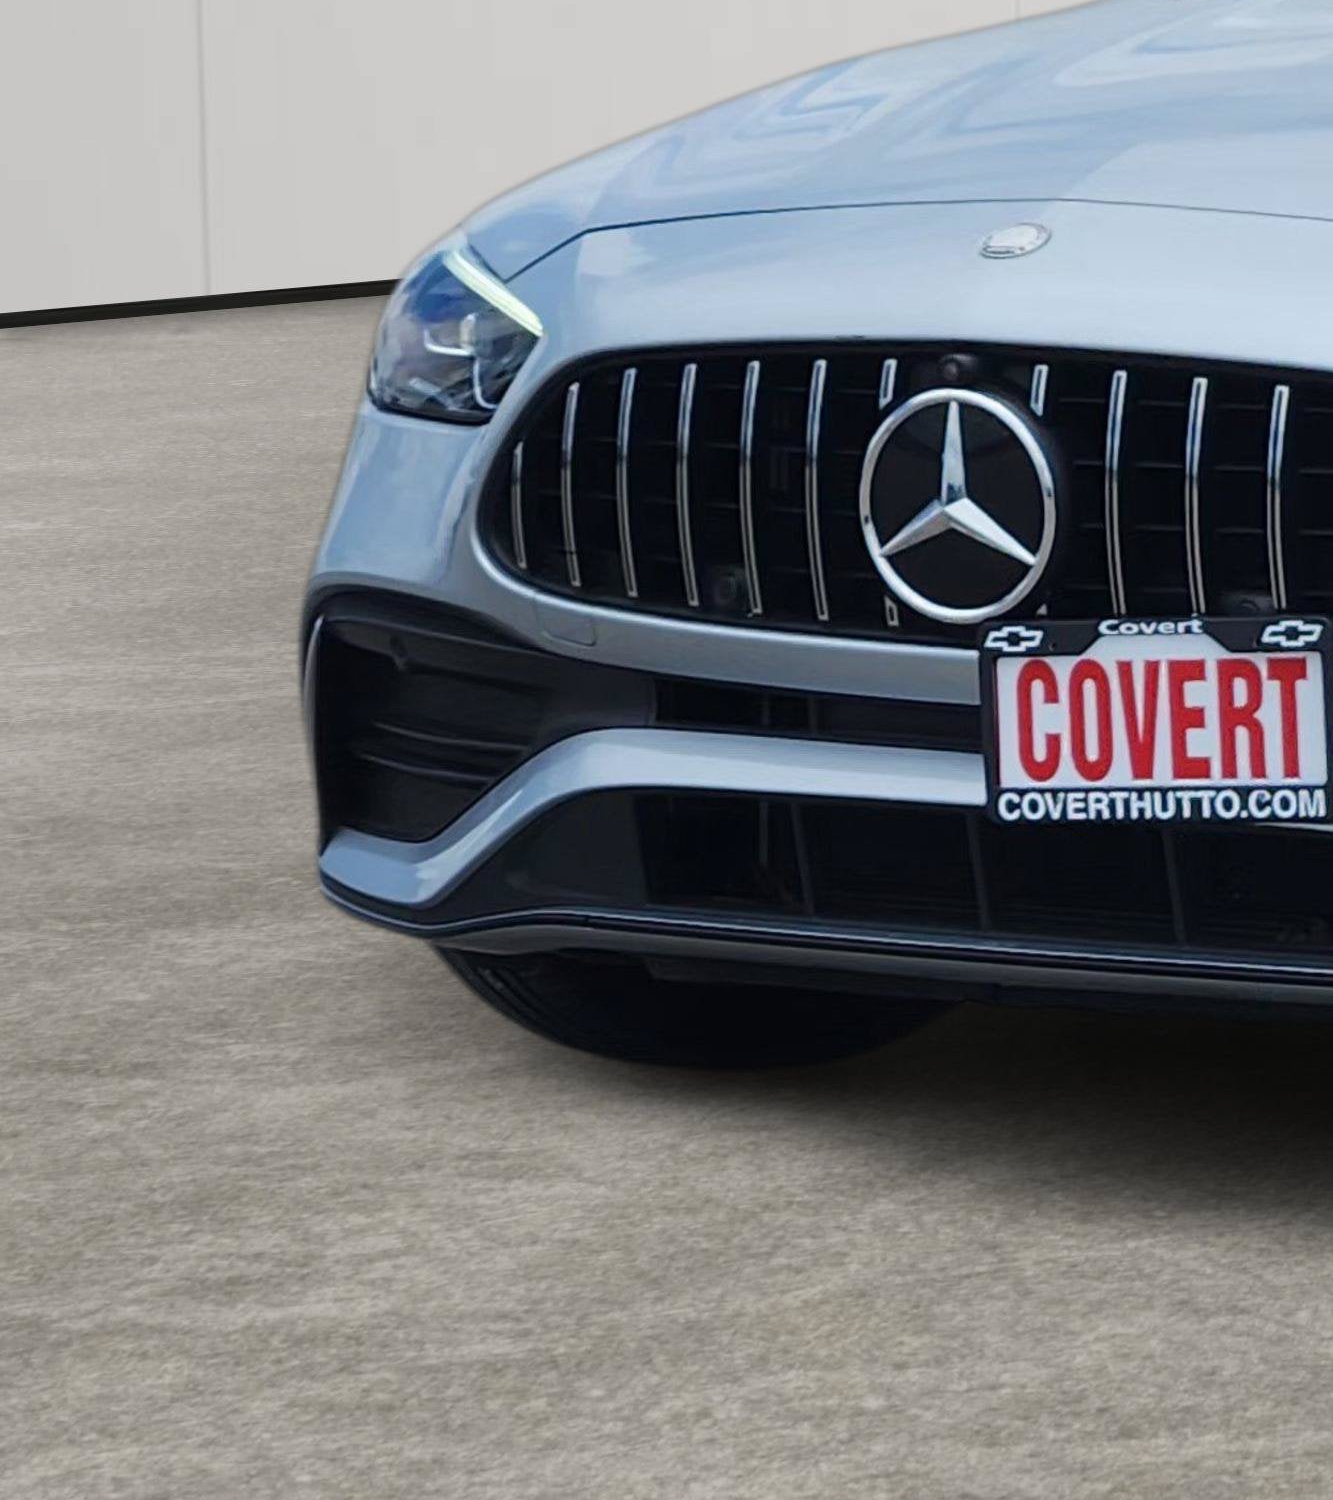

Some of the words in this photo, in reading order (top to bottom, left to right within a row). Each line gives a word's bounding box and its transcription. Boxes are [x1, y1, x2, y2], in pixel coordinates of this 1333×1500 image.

[1098, 615, 1205, 636] Covert
[1015, 656, 1308, 783] COVERT
[998, 787, 1327, 822] COVERTHUTTO.COM
